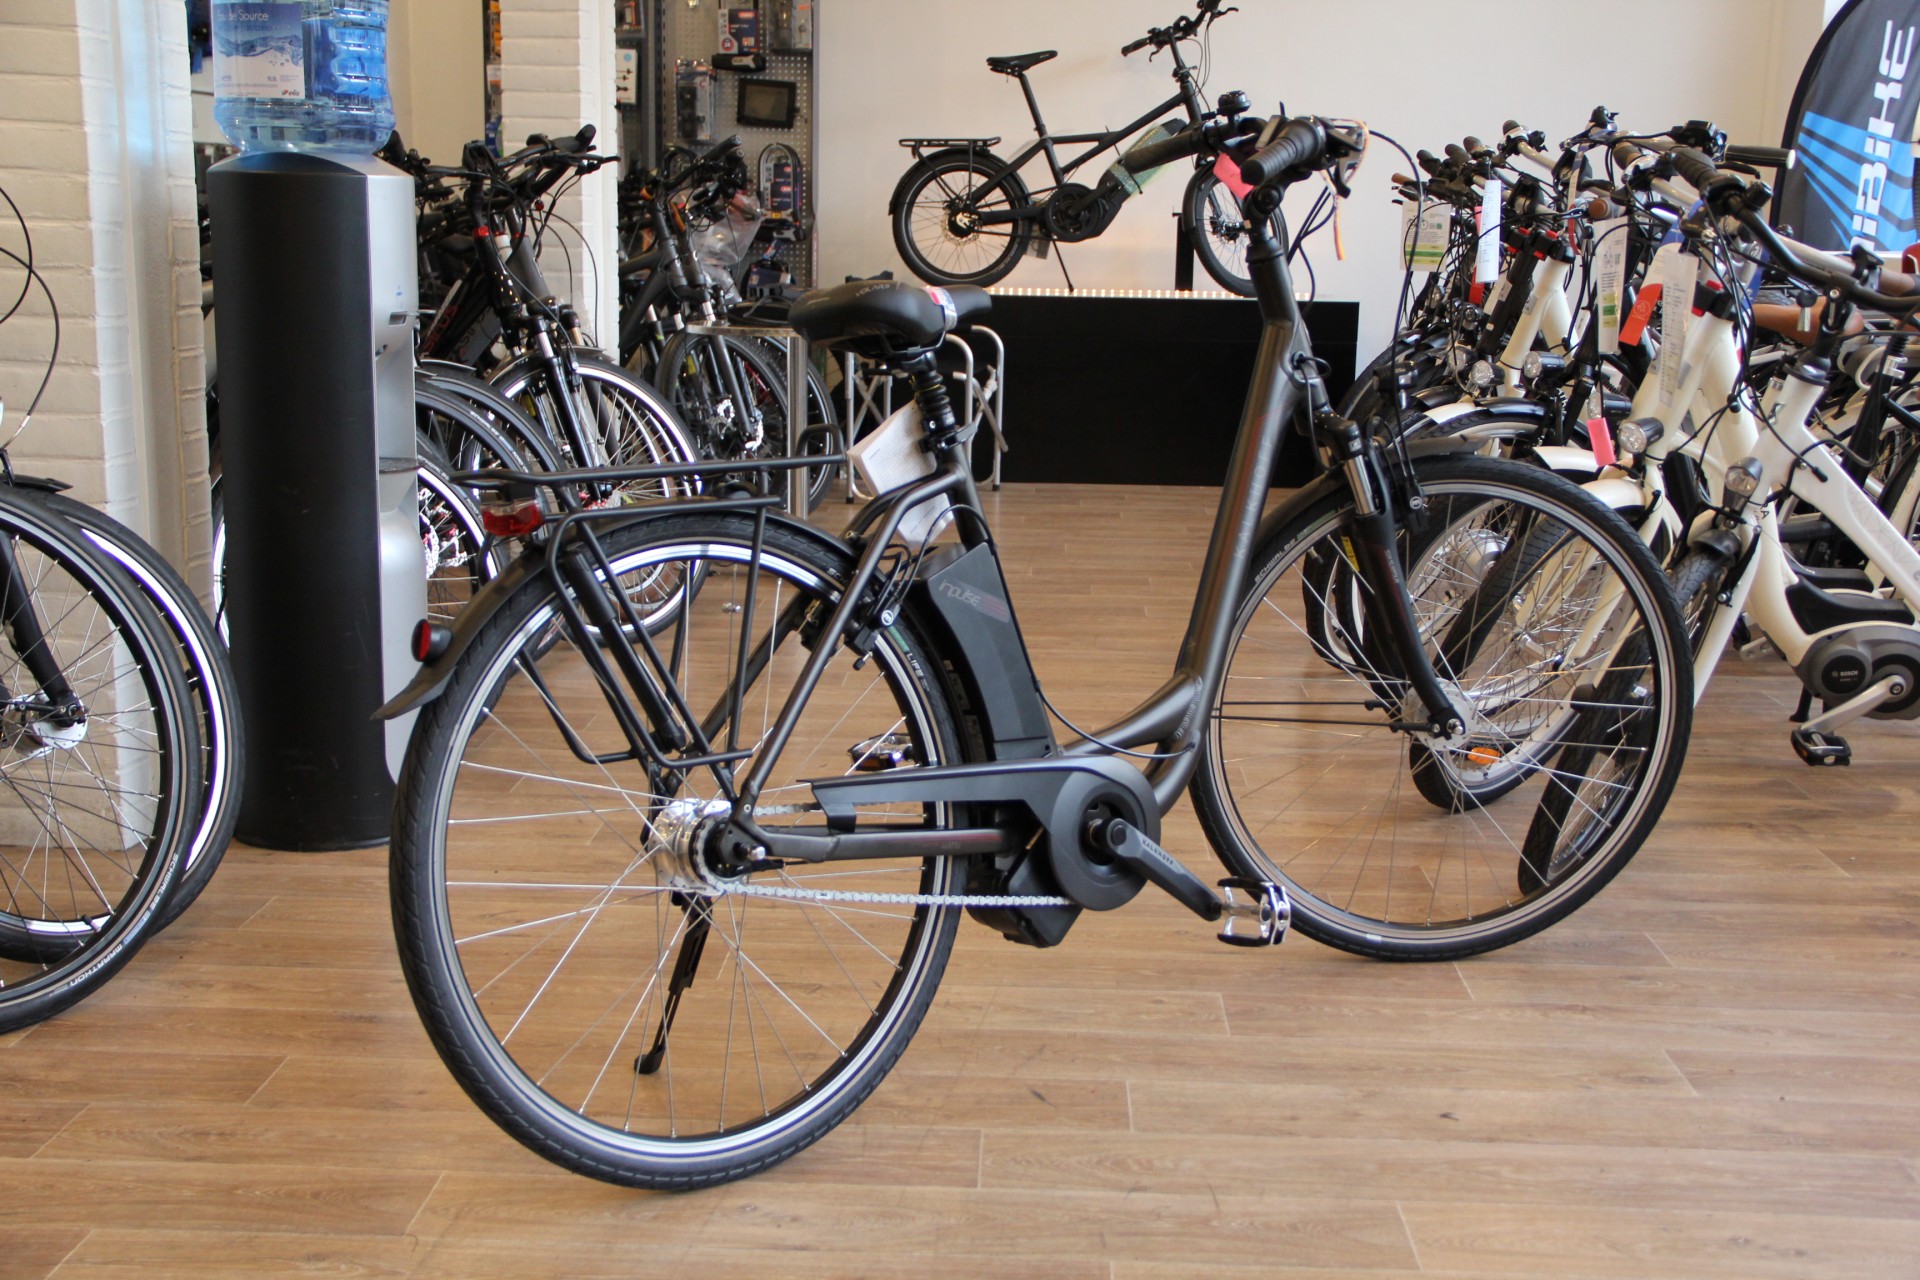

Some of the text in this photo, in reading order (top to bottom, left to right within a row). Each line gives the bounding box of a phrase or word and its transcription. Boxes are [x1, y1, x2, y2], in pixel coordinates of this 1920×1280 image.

[239, 10, 269, 21] Source
[1254, 538, 1297, 584] SCHWALBE
[906, 653, 924, 677] LIFE
[149, 853, 178, 910] SCHWALBE
[69, 943, 123, 987] MARATHON
